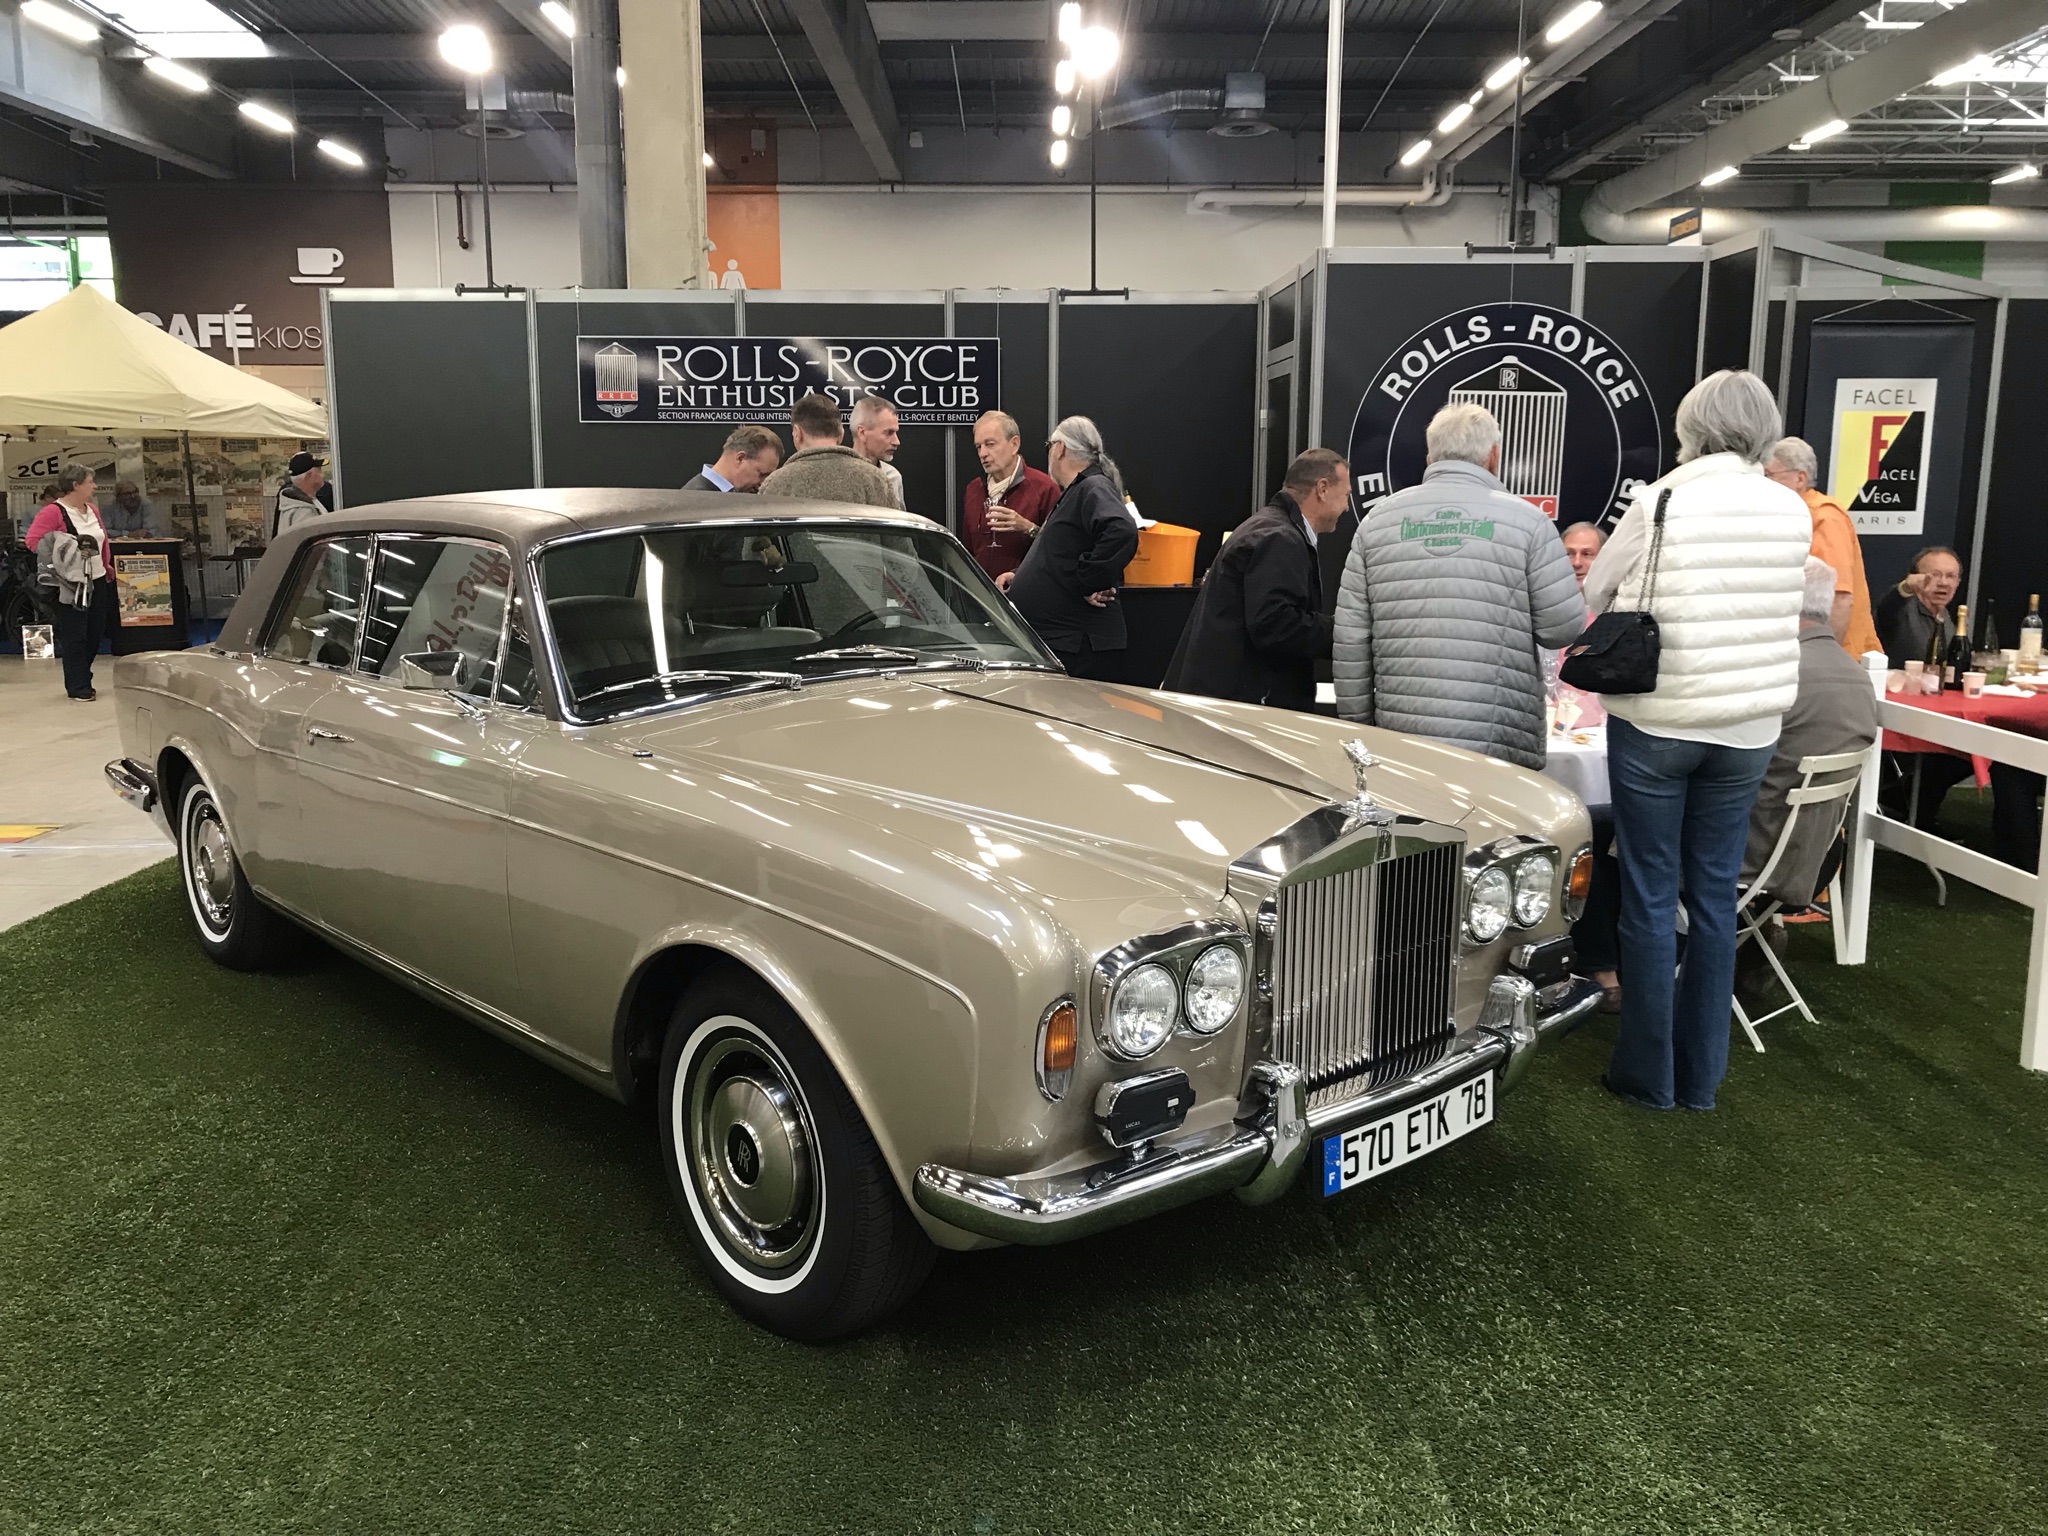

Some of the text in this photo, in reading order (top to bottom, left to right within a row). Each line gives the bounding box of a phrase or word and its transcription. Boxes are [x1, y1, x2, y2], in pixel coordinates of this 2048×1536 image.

[256, 325, 323, 349] KIOS
[893, 385, 980, 407] CLUB
[1853, 388, 1917, 405] FACEL
[657, 411, 690, 420] SECTION
[690, 411, 732, 421] FRANÇAISE
[733, 412, 745, 420] DU
[746, 412, 765, 420] CLUB
[936, 413, 946, 421] ET
[947, 413, 979, 421] BENTLEY
[1857, 515, 1906, 525] ARIS
[1343, 1078, 1486, 1181] 570 ETK 78
[1328, 1171, 1336, 1186] F
